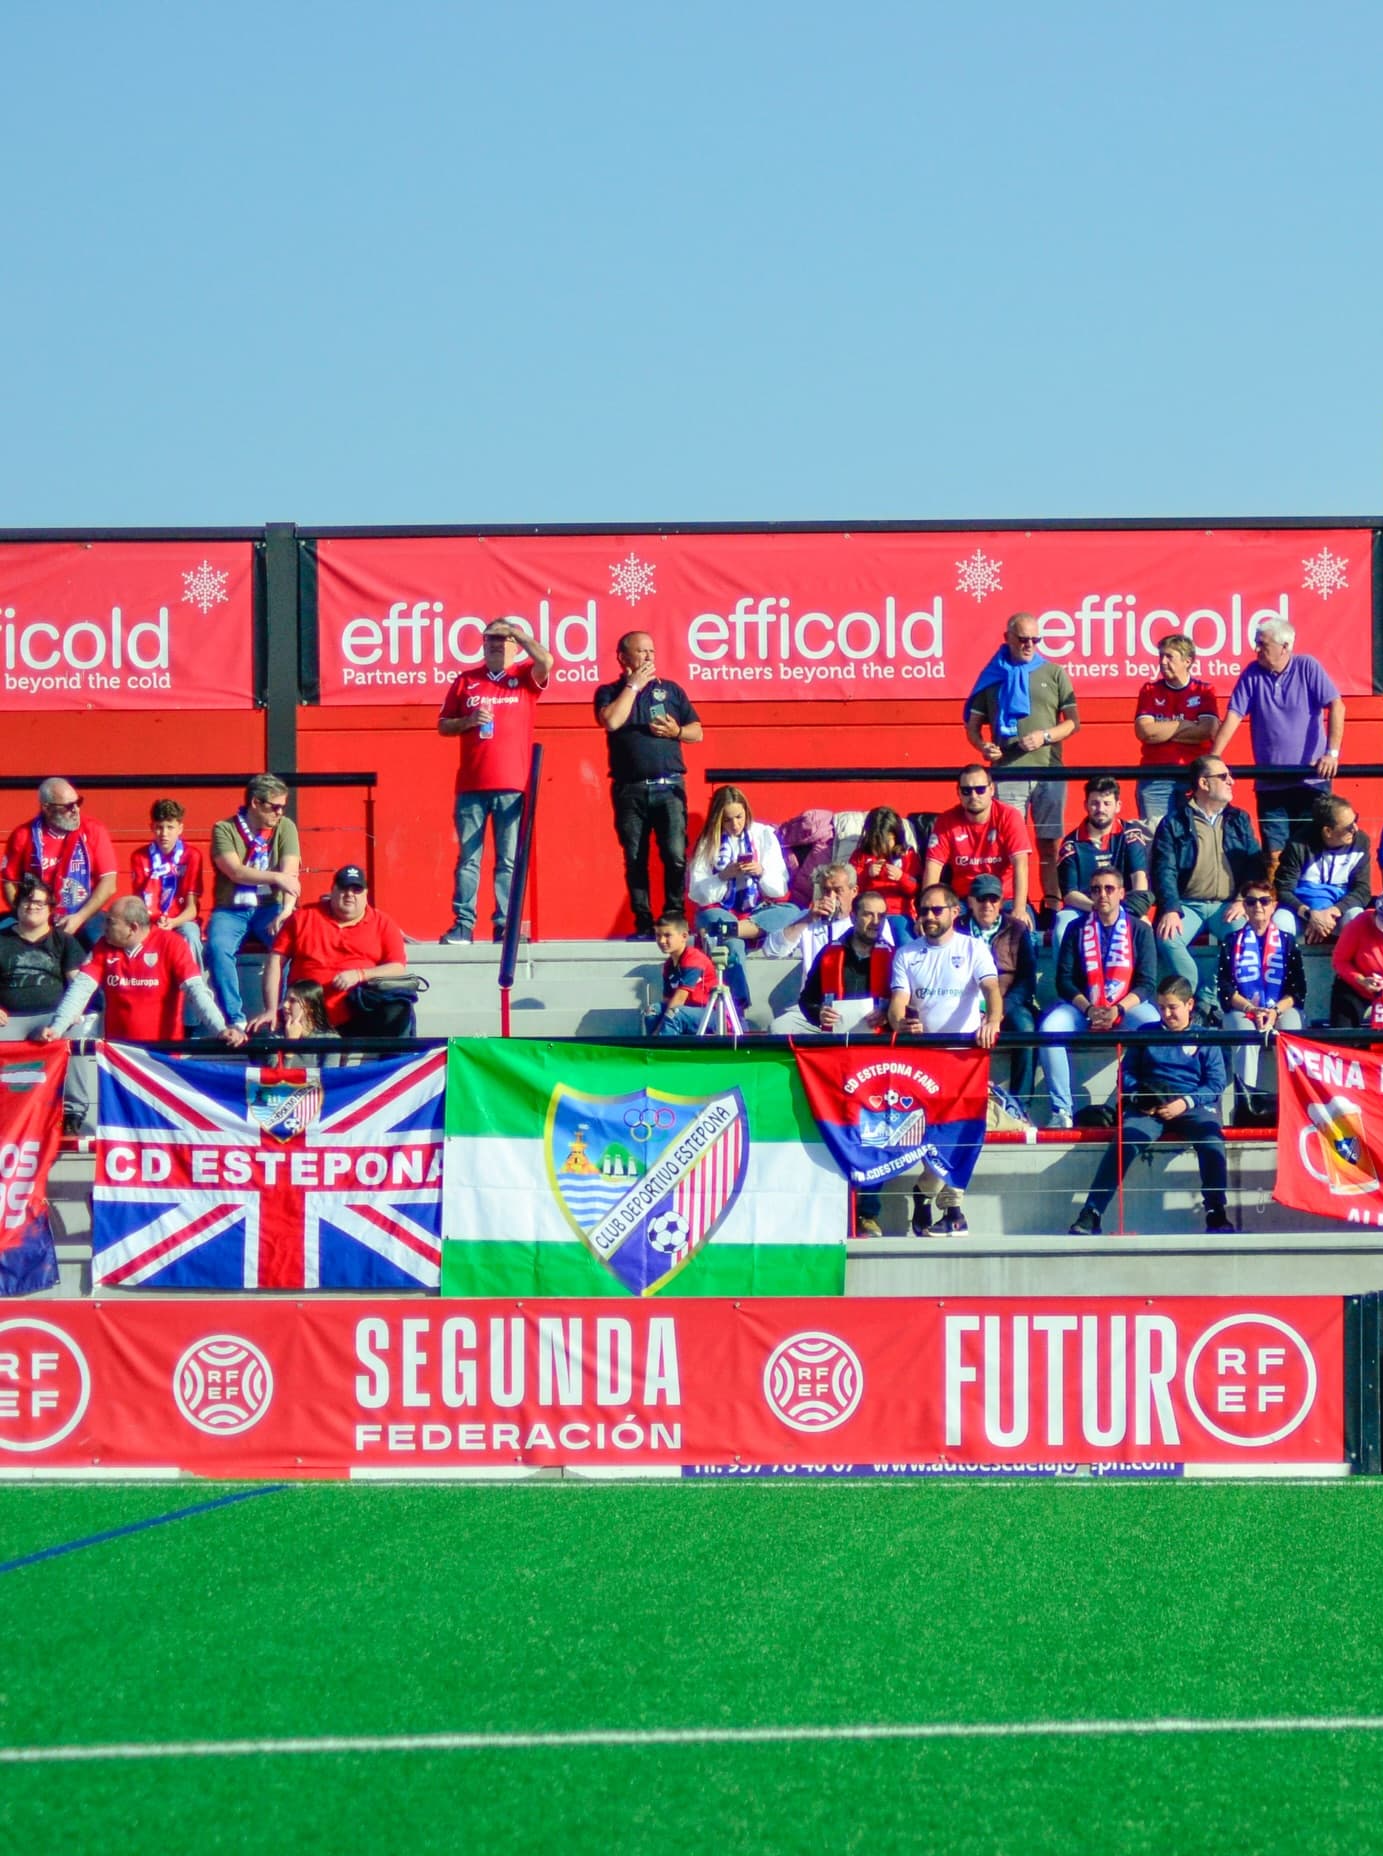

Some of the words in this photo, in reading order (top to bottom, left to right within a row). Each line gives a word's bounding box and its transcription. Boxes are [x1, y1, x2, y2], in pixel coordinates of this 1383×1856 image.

[0, 607, 169, 670] icold
[687, 596, 944, 660] efficold
[4, 672, 82, 693] beyond
[87, 672, 121, 689] the
[127, 672, 172, 689] cold
[342, 667, 427, 685] Partners
[555, 665, 600, 682] cold
[688, 663, 773, 680] Partners
[778, 662, 856, 683] beyond
[862, 662, 895, 679] the
[901, 661, 946, 679] cold
[1061, 661, 1119, 678] rtners
[1208, 660, 1241, 677] the
[843, 1078, 859, 1094] CD
[856, 1063, 912, 1082] ESTEPONA
[913, 1070, 940, 1095] FANS
[1286, 1044, 1365, 1089] PEÑA
[105, 1147, 172, 1182] CD
[192, 1149, 444, 1186] ESTEPONA
[595, 1217, 627, 1250] CLUB
[620, 1160, 680, 1223] DEPORTIVO
[673, 1105, 731, 1167] ESTEPONA
[0, 1180, 36, 1230] S
[355, 1316, 681, 1409] SEGUNDA
[797, 1366, 829, 1380] RF
[1217, 1347, 1286, 1375] RF
[207, 1369, 239, 1382] RF
[207, 1386, 239, 1400] EF
[797, 1383, 829, 1397] EF
[1217, 1385, 1286, 1412] EF
[355, 1414, 682, 1451] FEDERACIÓN
